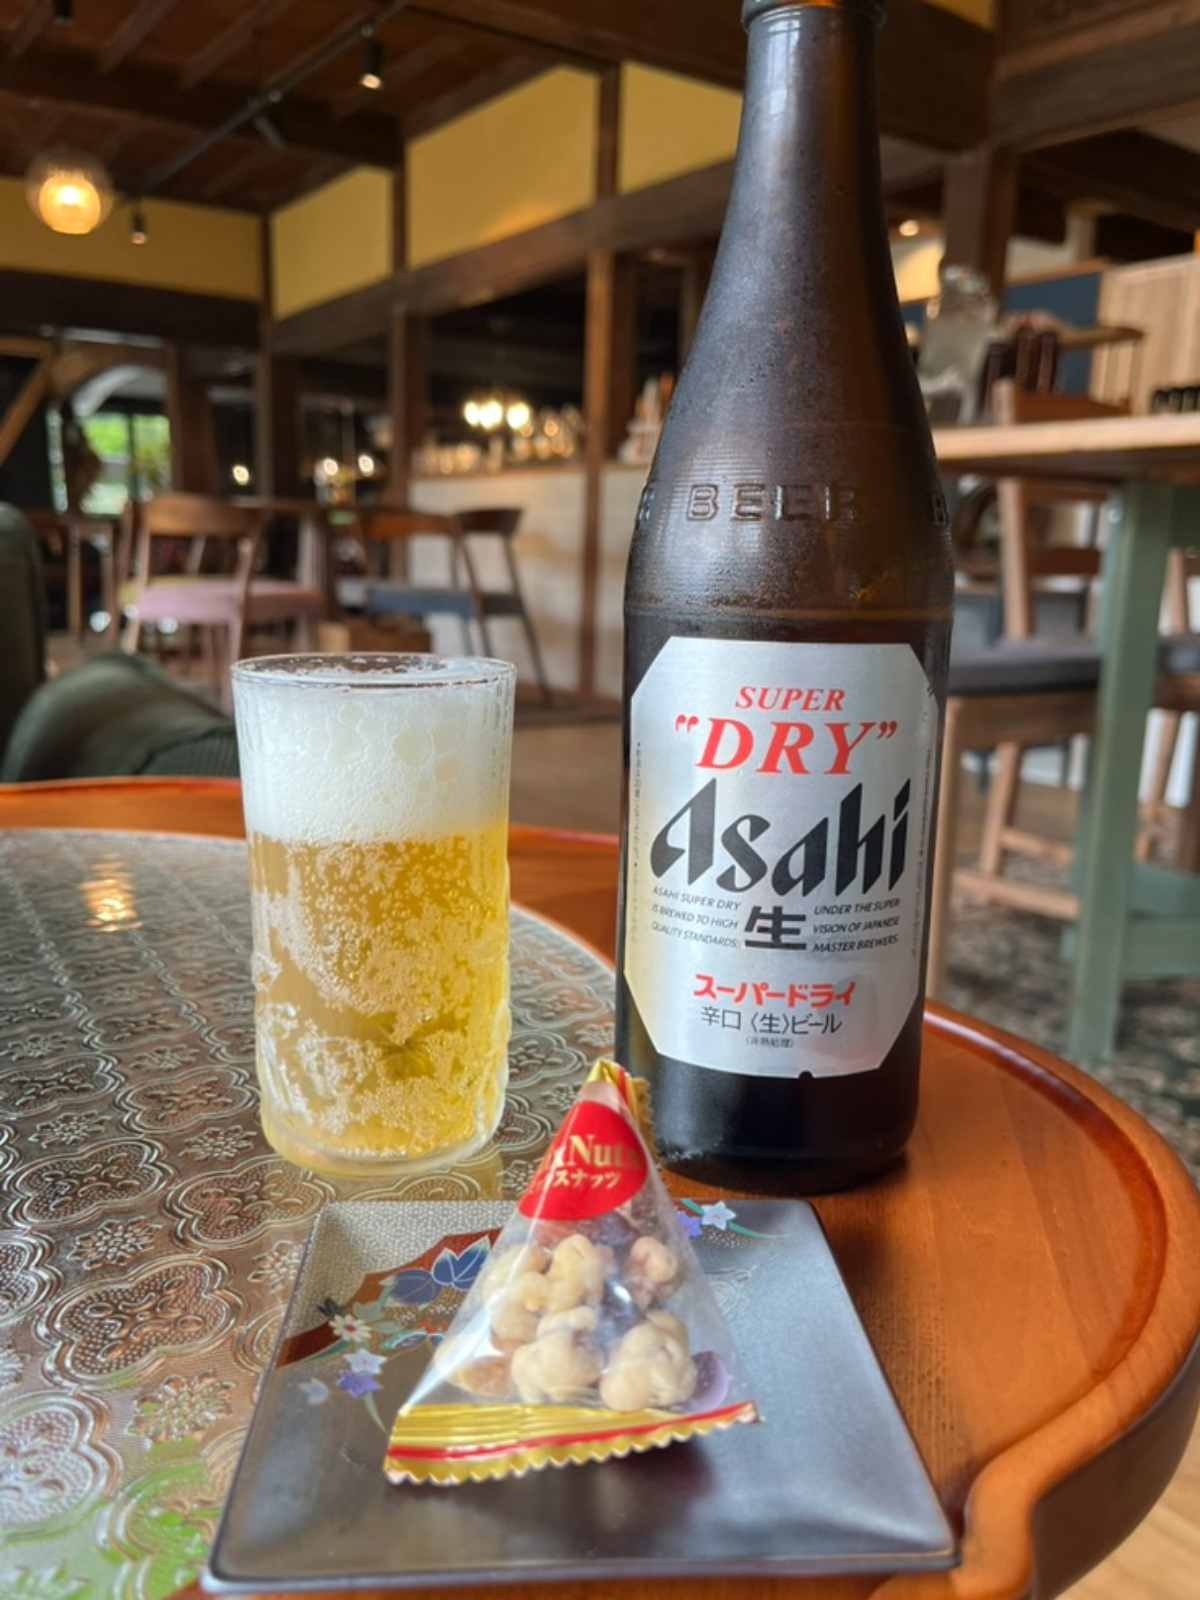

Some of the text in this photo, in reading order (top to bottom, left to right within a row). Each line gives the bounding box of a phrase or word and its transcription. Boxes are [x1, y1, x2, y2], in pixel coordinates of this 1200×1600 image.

[686, 483, 859, 522] BEER
[735, 686, 845, 711] SUPER
[650, 777, 911, 898] Asahi
[652, 886, 741, 910] ASAHI SUPER DRY
[814, 904, 852, 915] UNDER
[855, 902, 872, 912] THE
[651, 920, 682, 937] QUALITY
[696, 914, 710, 925] TO
[711, 918, 739, 930] HIGH
[744, 905, 806, 951] 生
[813, 923, 847, 933] VISION
[848, 922, 862, 932] OF
[812, 941, 856, 952] MASTER
[693, 973, 857, 1009] スーパードライ
